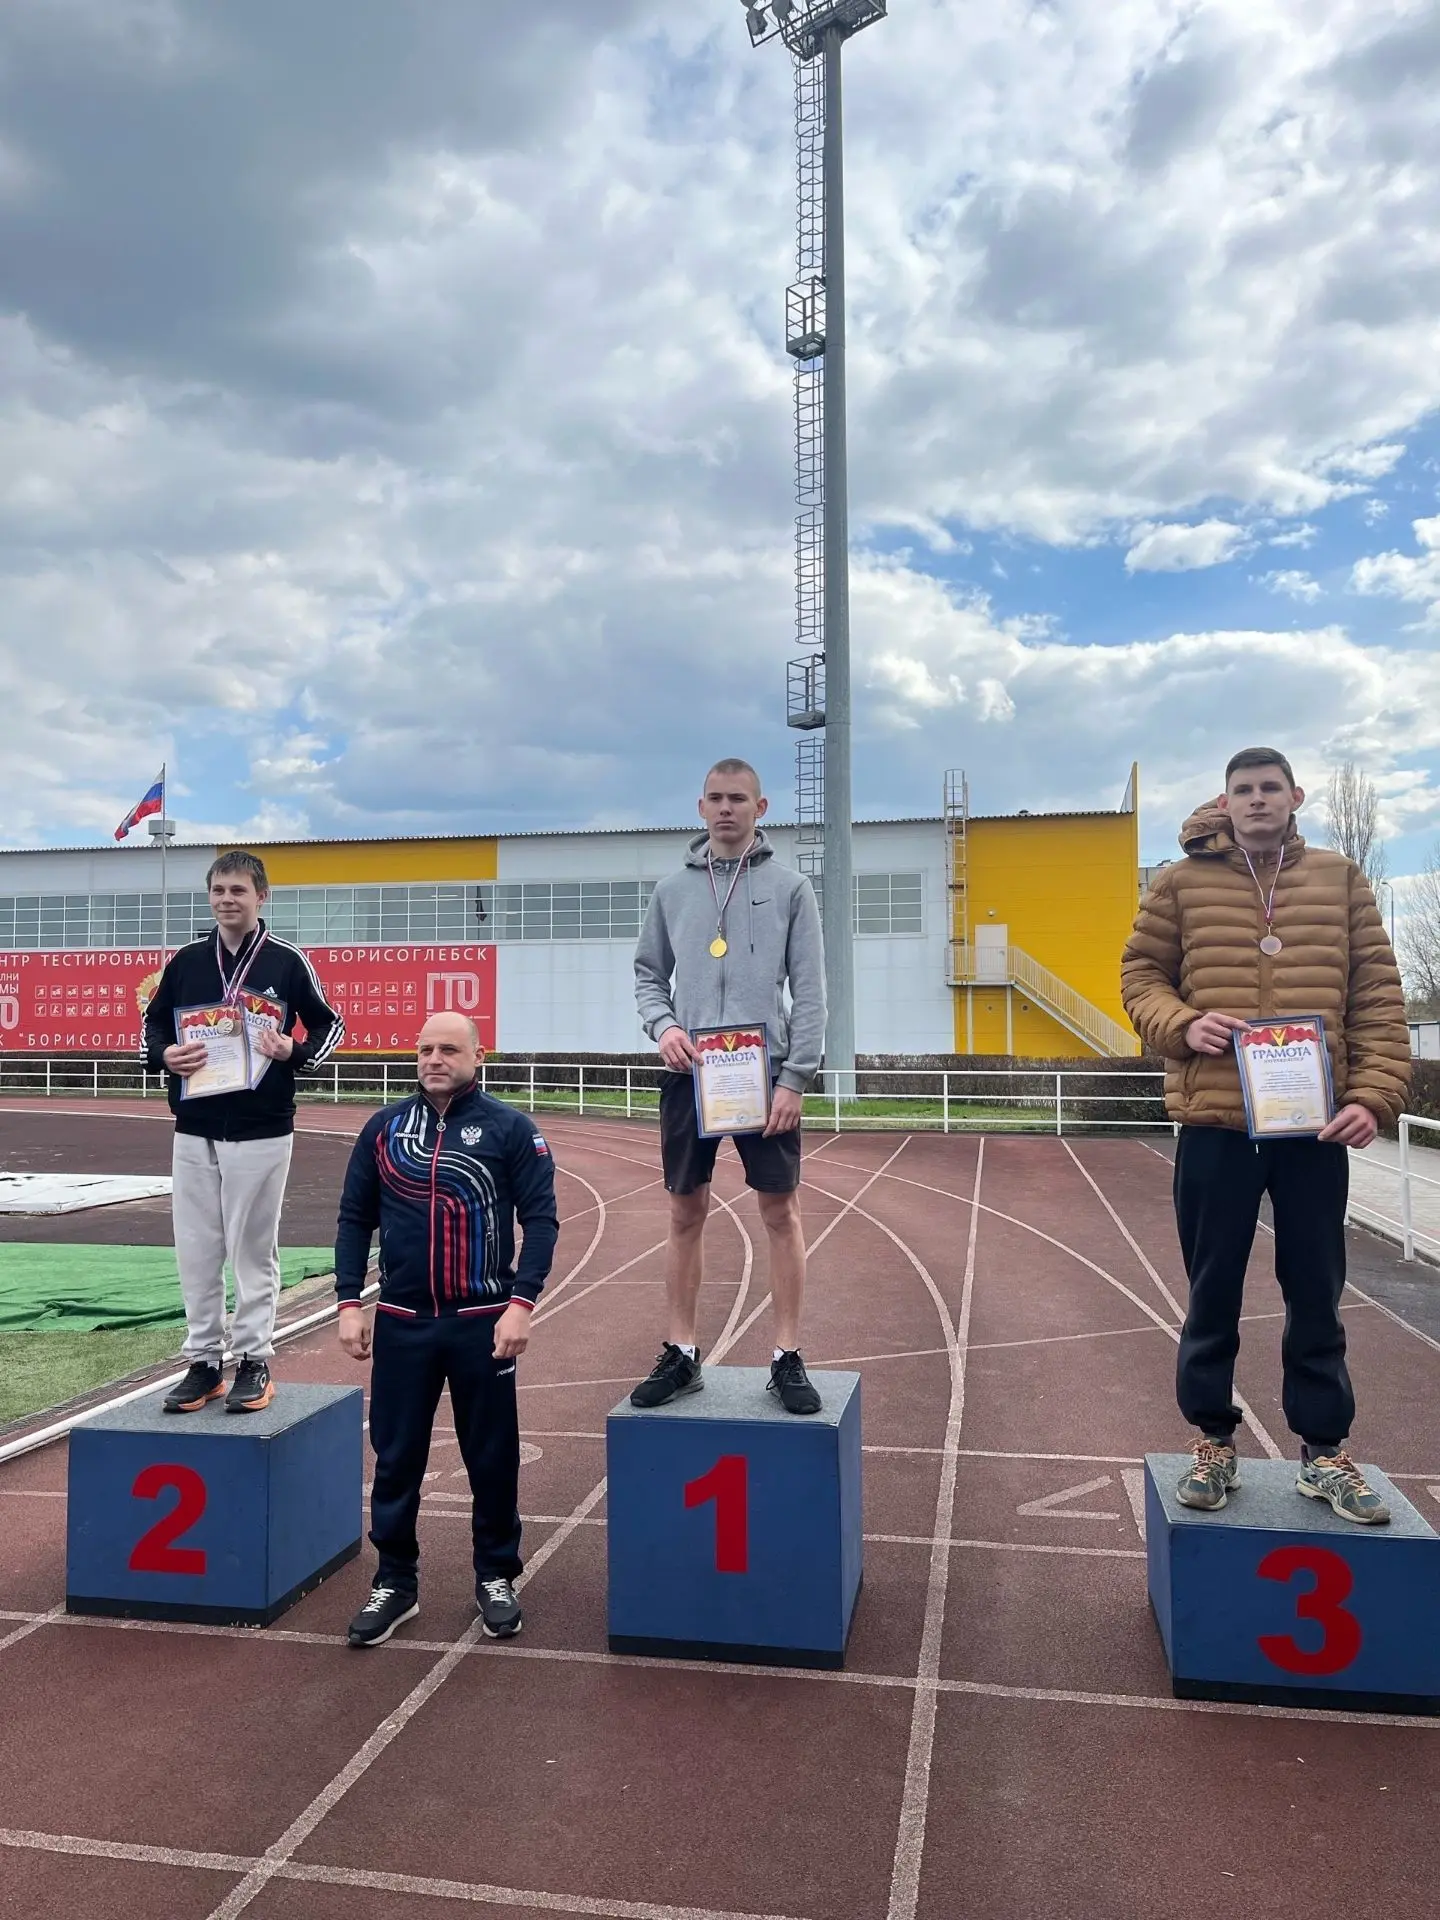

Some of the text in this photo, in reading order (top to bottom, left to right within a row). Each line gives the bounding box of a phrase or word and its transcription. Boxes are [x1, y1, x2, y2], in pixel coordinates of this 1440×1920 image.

[41, 952, 172, 967] ТЕСТИРОВАНИ
[329, 947, 488, 963] БОРИСОГЛЕБСК
[705, 1051, 757, 1065] ГРАМОТА
[1252, 1046, 1312, 1060] ГРАМОТА
[128, 1463, 207, 1575] 2
[683, 1454, 748, 1574] 1
[1255, 1544, 1362, 1676] 3
